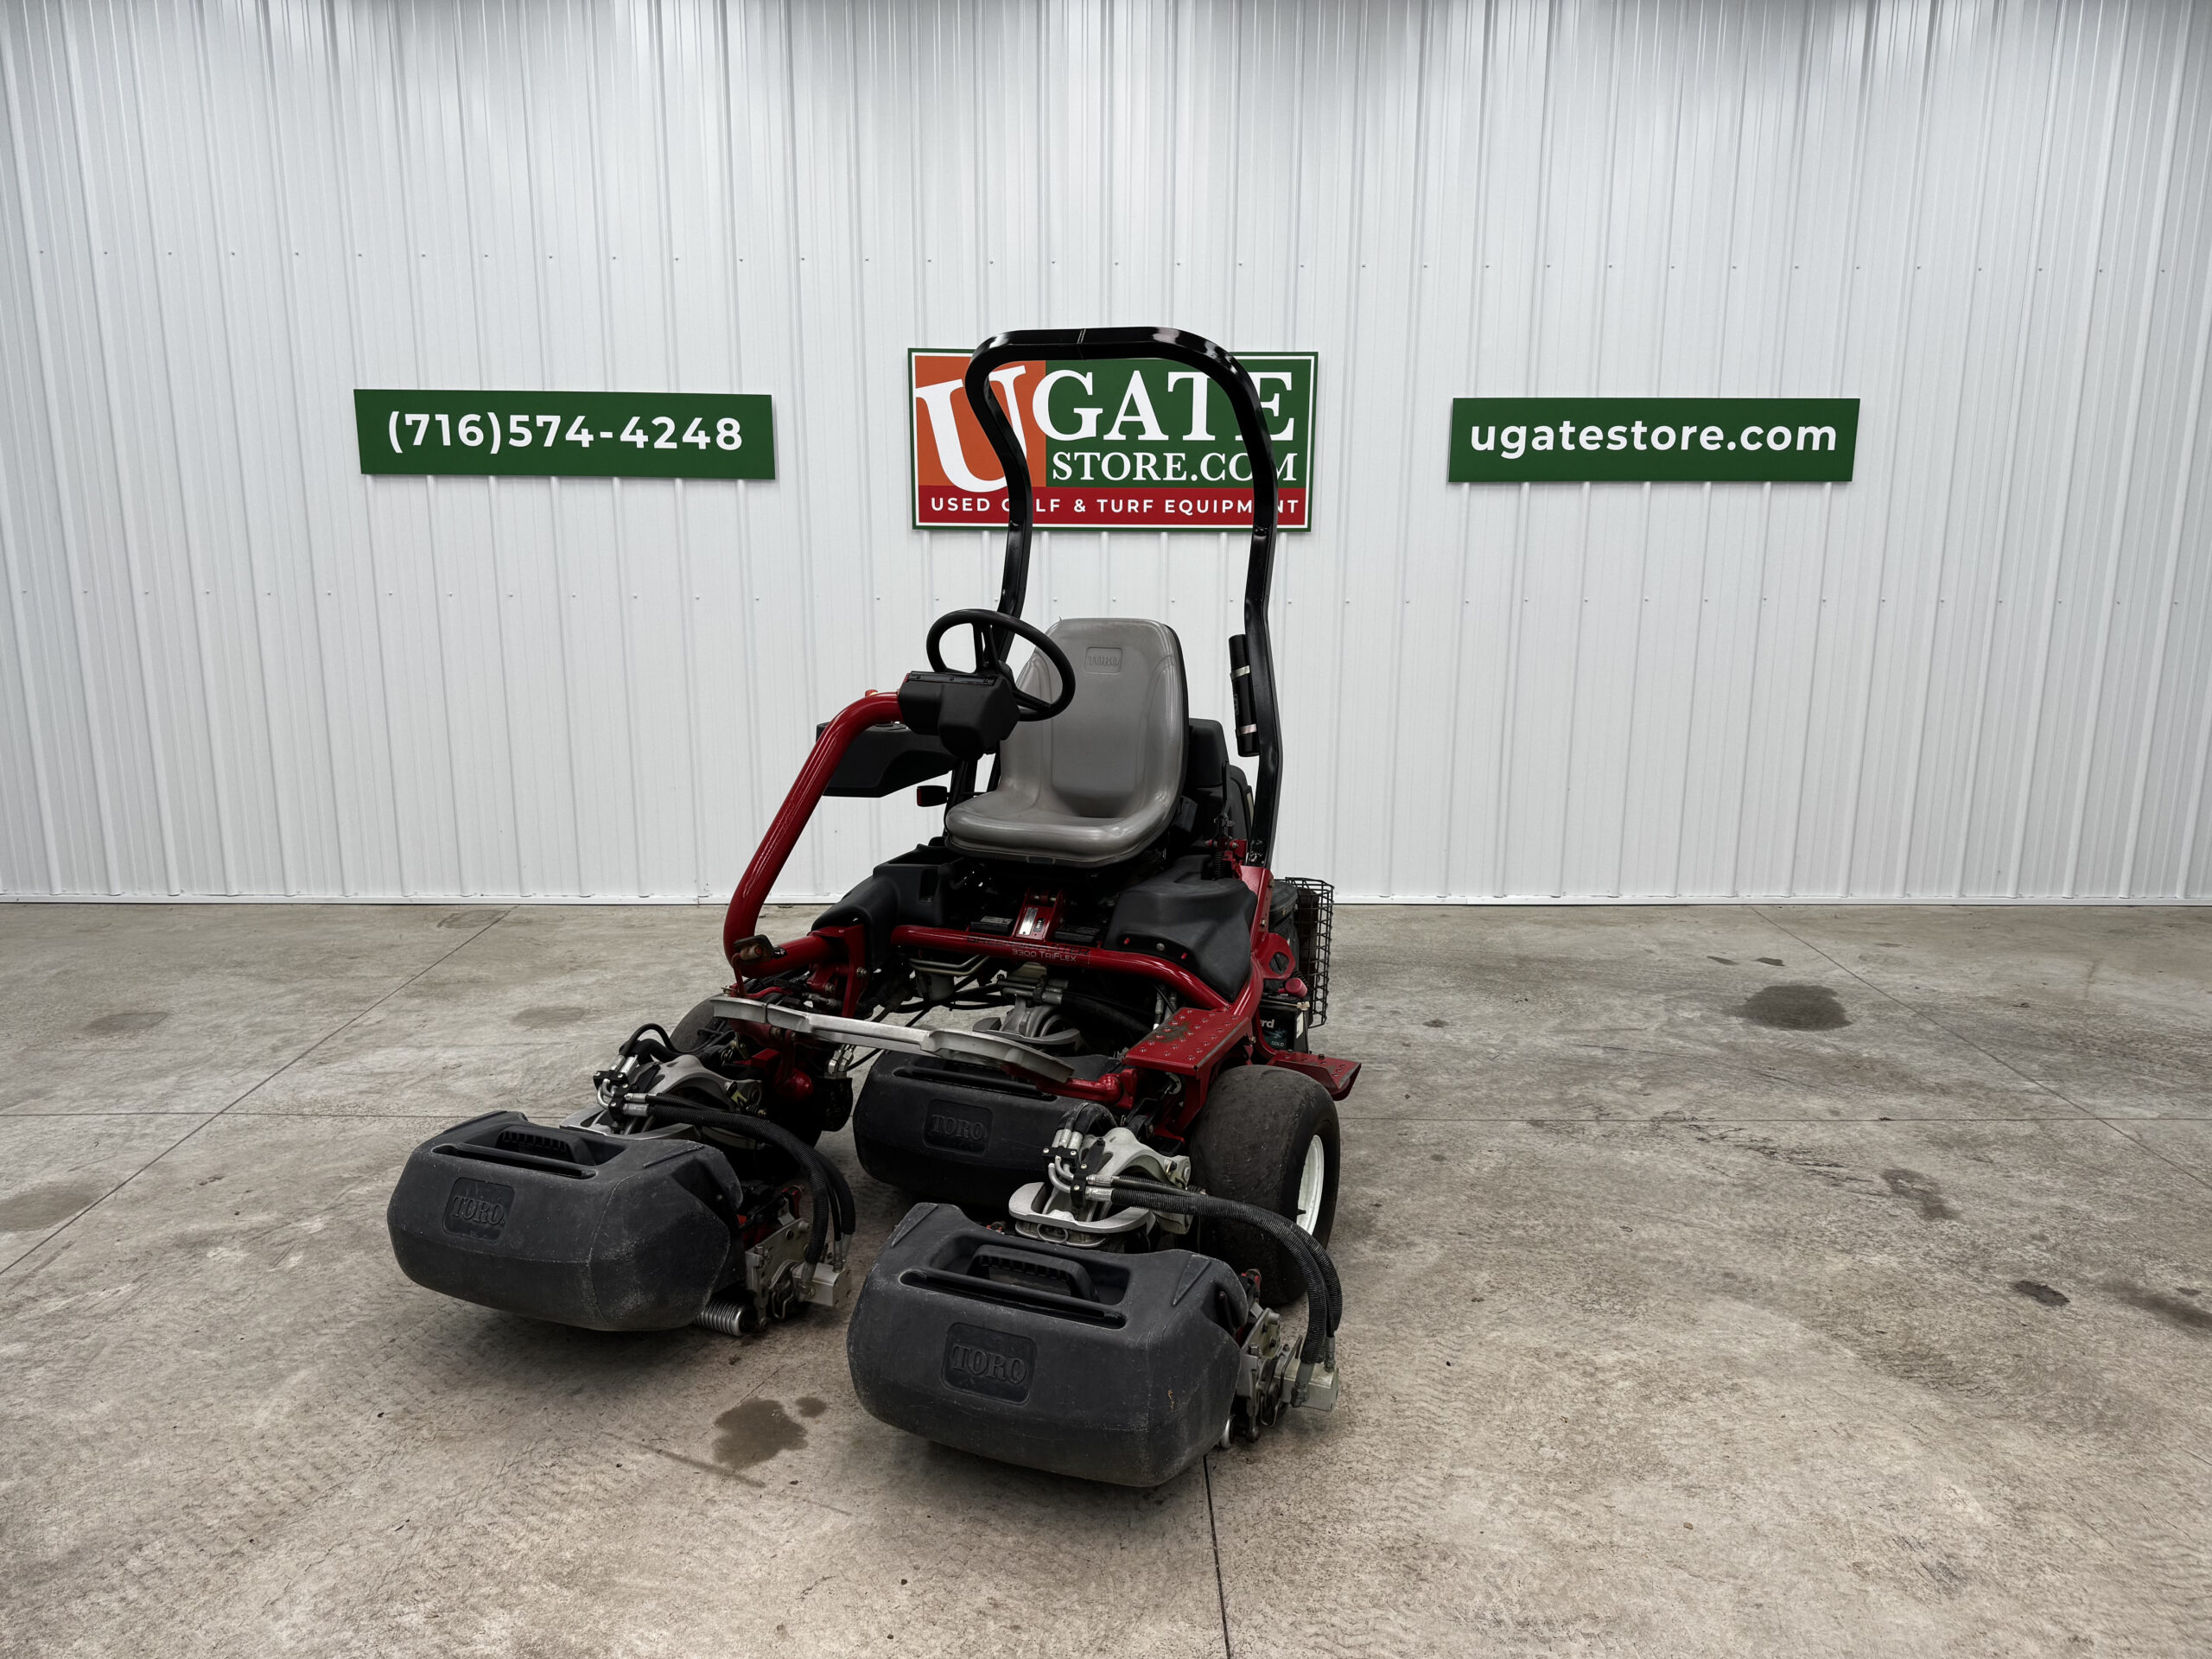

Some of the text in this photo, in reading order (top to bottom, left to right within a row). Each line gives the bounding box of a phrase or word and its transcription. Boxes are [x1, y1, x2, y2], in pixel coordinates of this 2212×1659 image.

[388, 411, 743, 454] (716)574-4248
[1471, 420, 1837, 460] ugatestore.com
[1052, 451, 1298, 482] STORE.COM
[931, 497, 1299, 516] USED GLF & TURF EQUIPMT
[1012, 949, 1037, 957] 3300
[1260, 1019, 1275, 1029] rd
[931, 1115, 985, 1141] TORO
[451, 1196, 505, 1225] TORO
[952, 1344, 1027, 1385] TORO
